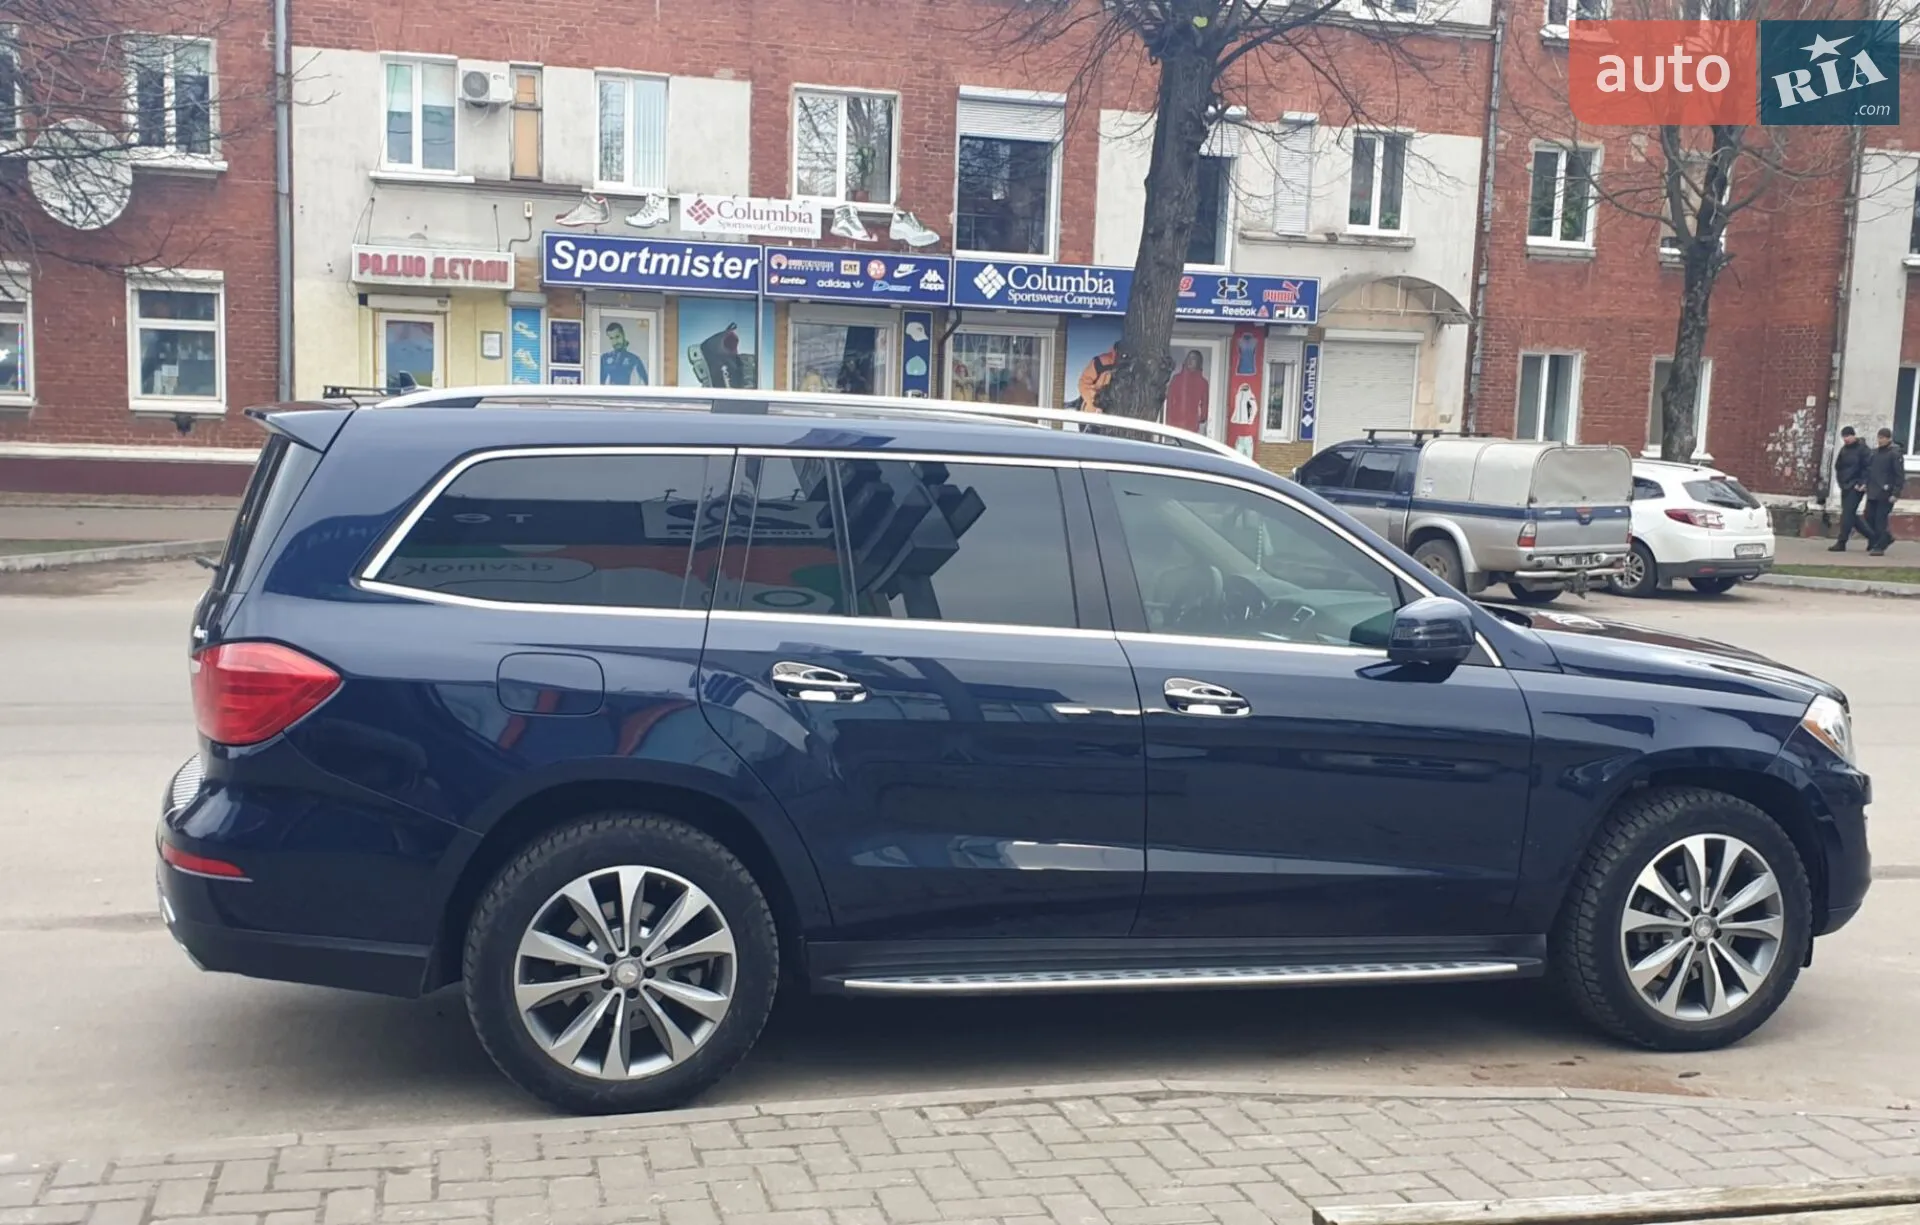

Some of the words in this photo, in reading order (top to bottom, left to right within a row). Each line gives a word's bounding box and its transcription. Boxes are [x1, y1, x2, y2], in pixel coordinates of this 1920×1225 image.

[717, 200, 814, 224] Columbia
[718, 219, 767, 232] Sportswear
[358, 252, 426, 278] РАДИО
[430, 257, 509, 283] ДЕТАЛИ
[551, 240, 760, 280] Sportmister
[816, 279, 852, 289] adidas
[1007, 265, 1116, 295] Columbia
[1007, 289, 1064, 304] Sportswear
[1065, 292, 1114, 309] Company
[1222, 305, 1257, 318] Reebok
[1275, 306, 1307, 319] FILA
[1303, 357, 1318, 412] Columbia
